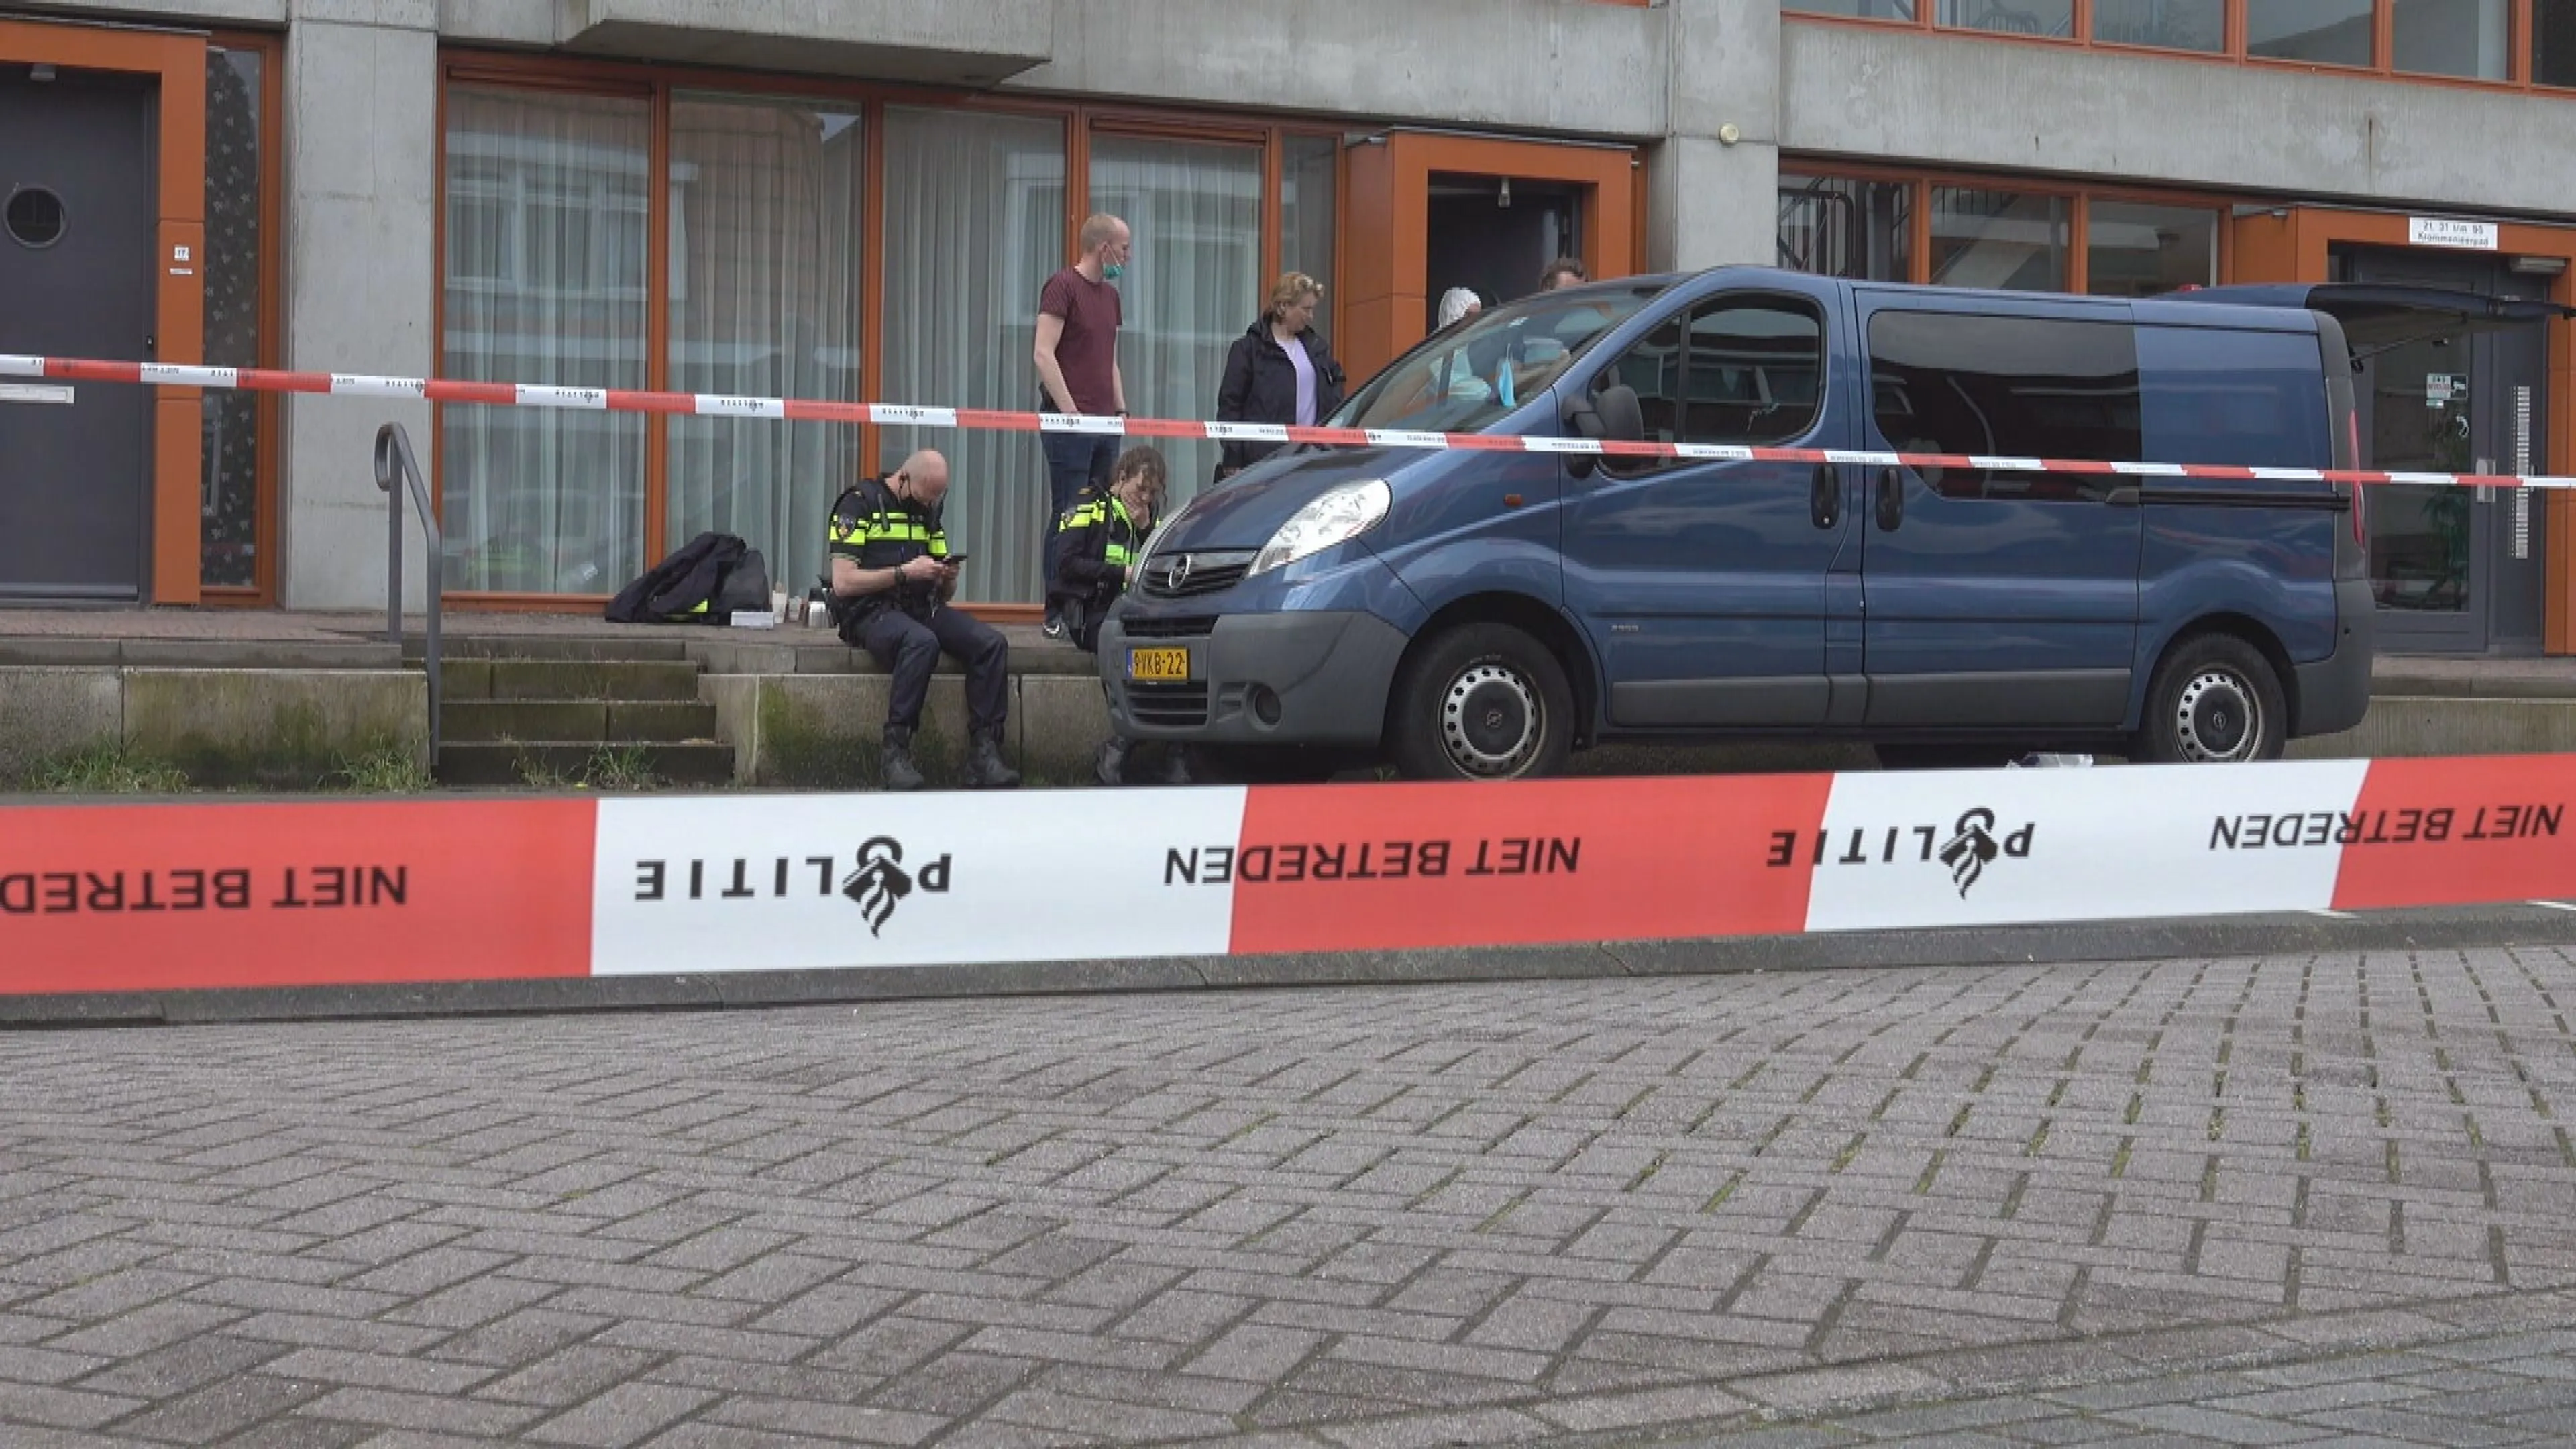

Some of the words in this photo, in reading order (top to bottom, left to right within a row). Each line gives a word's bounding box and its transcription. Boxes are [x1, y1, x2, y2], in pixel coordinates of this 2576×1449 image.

[2209, 807, 2455, 850] BETREDEN
[2462, 804, 2563, 840] NIET
[1165, 839, 1450, 885] BETREDEN
[1466, 837, 1581, 876] NIET
[272, 866, 407, 908] NIET
